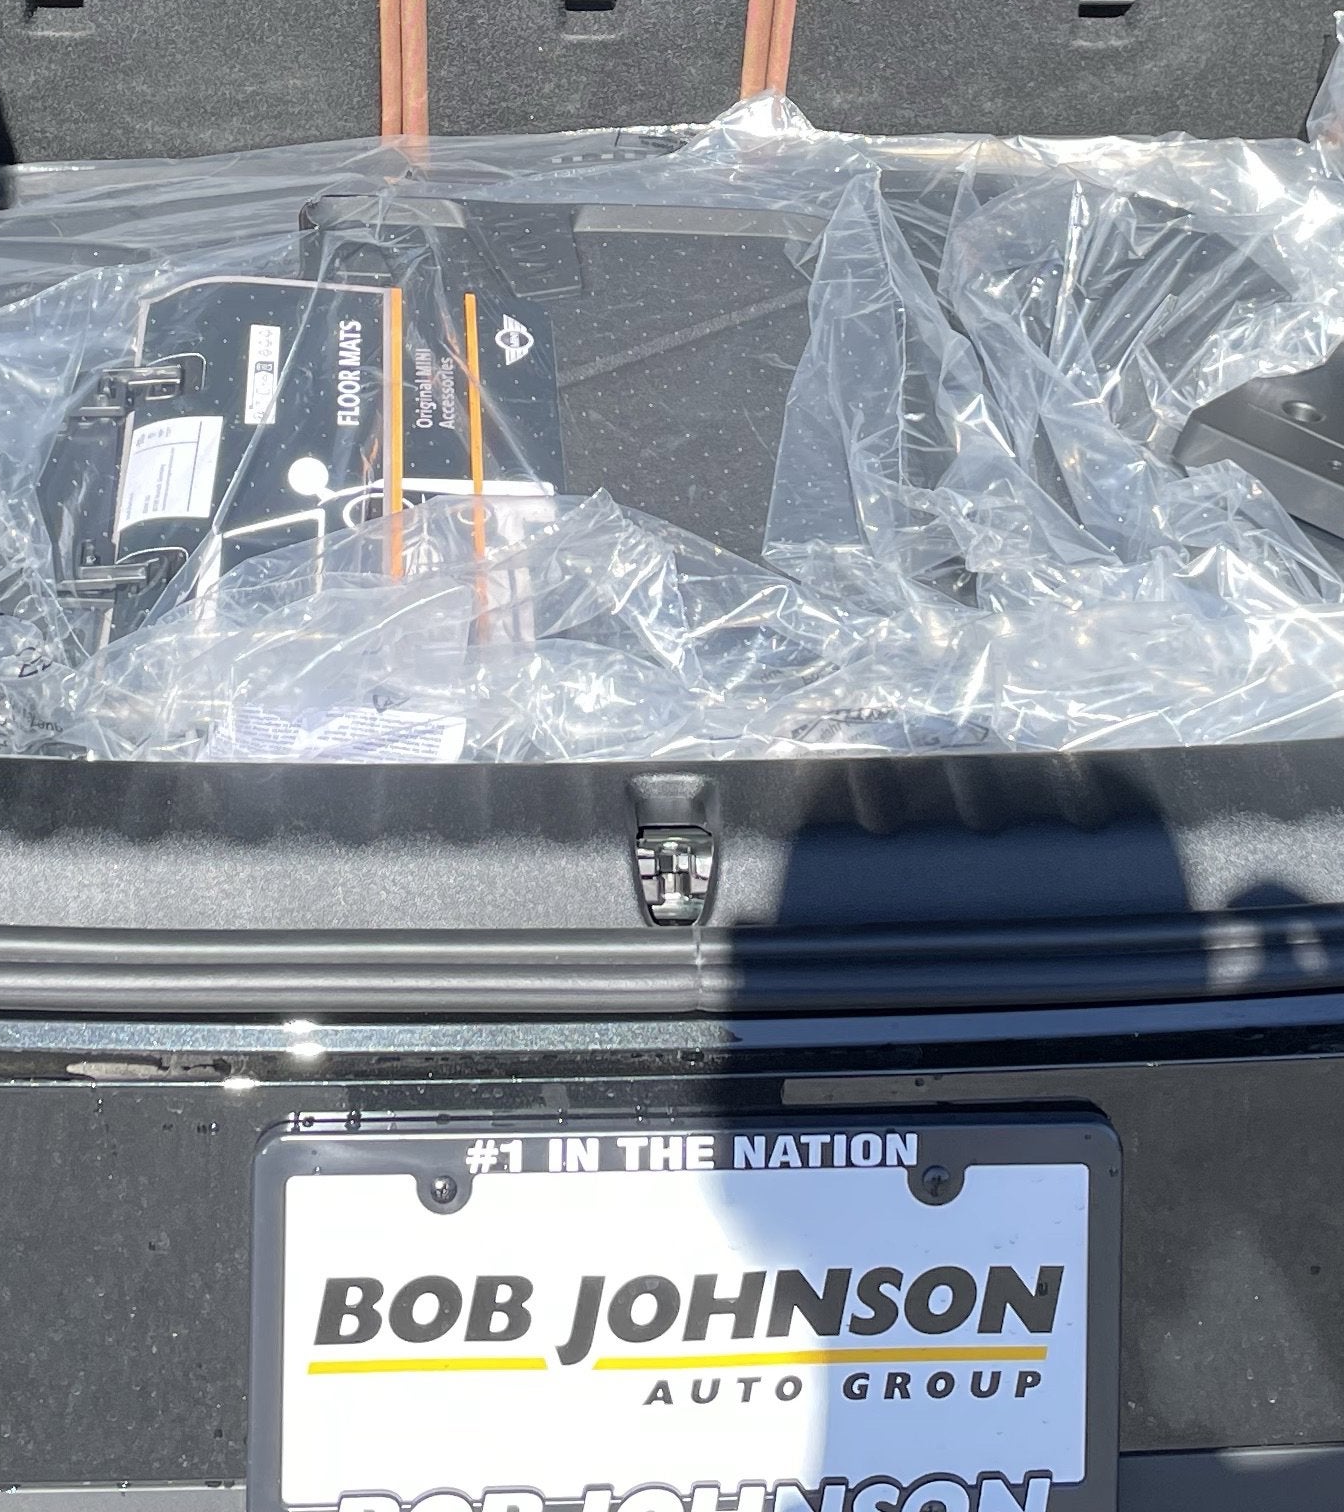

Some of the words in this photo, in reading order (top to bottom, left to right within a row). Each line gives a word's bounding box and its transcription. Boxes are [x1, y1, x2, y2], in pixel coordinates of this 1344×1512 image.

[338, 319, 362, 367] MATS
[415, 348, 432, 379] MINI
[337, 370, 361, 426] FLOOR
[414, 379, 436, 429] Original
[438, 356, 457, 430] Accessories
[466, 1139, 523, 1174] #1
[547, 1138, 600, 1173] IN
[616, 1135, 716, 1172] THE
[733, 1132, 919, 1170] NATION
[313, 1274, 535, 1346] BOB
[555, 1265, 1065, 1367] JOHNSON
[642, 1375, 804, 1406] AUTO
[842, 1370, 1044, 1402] GROUP
